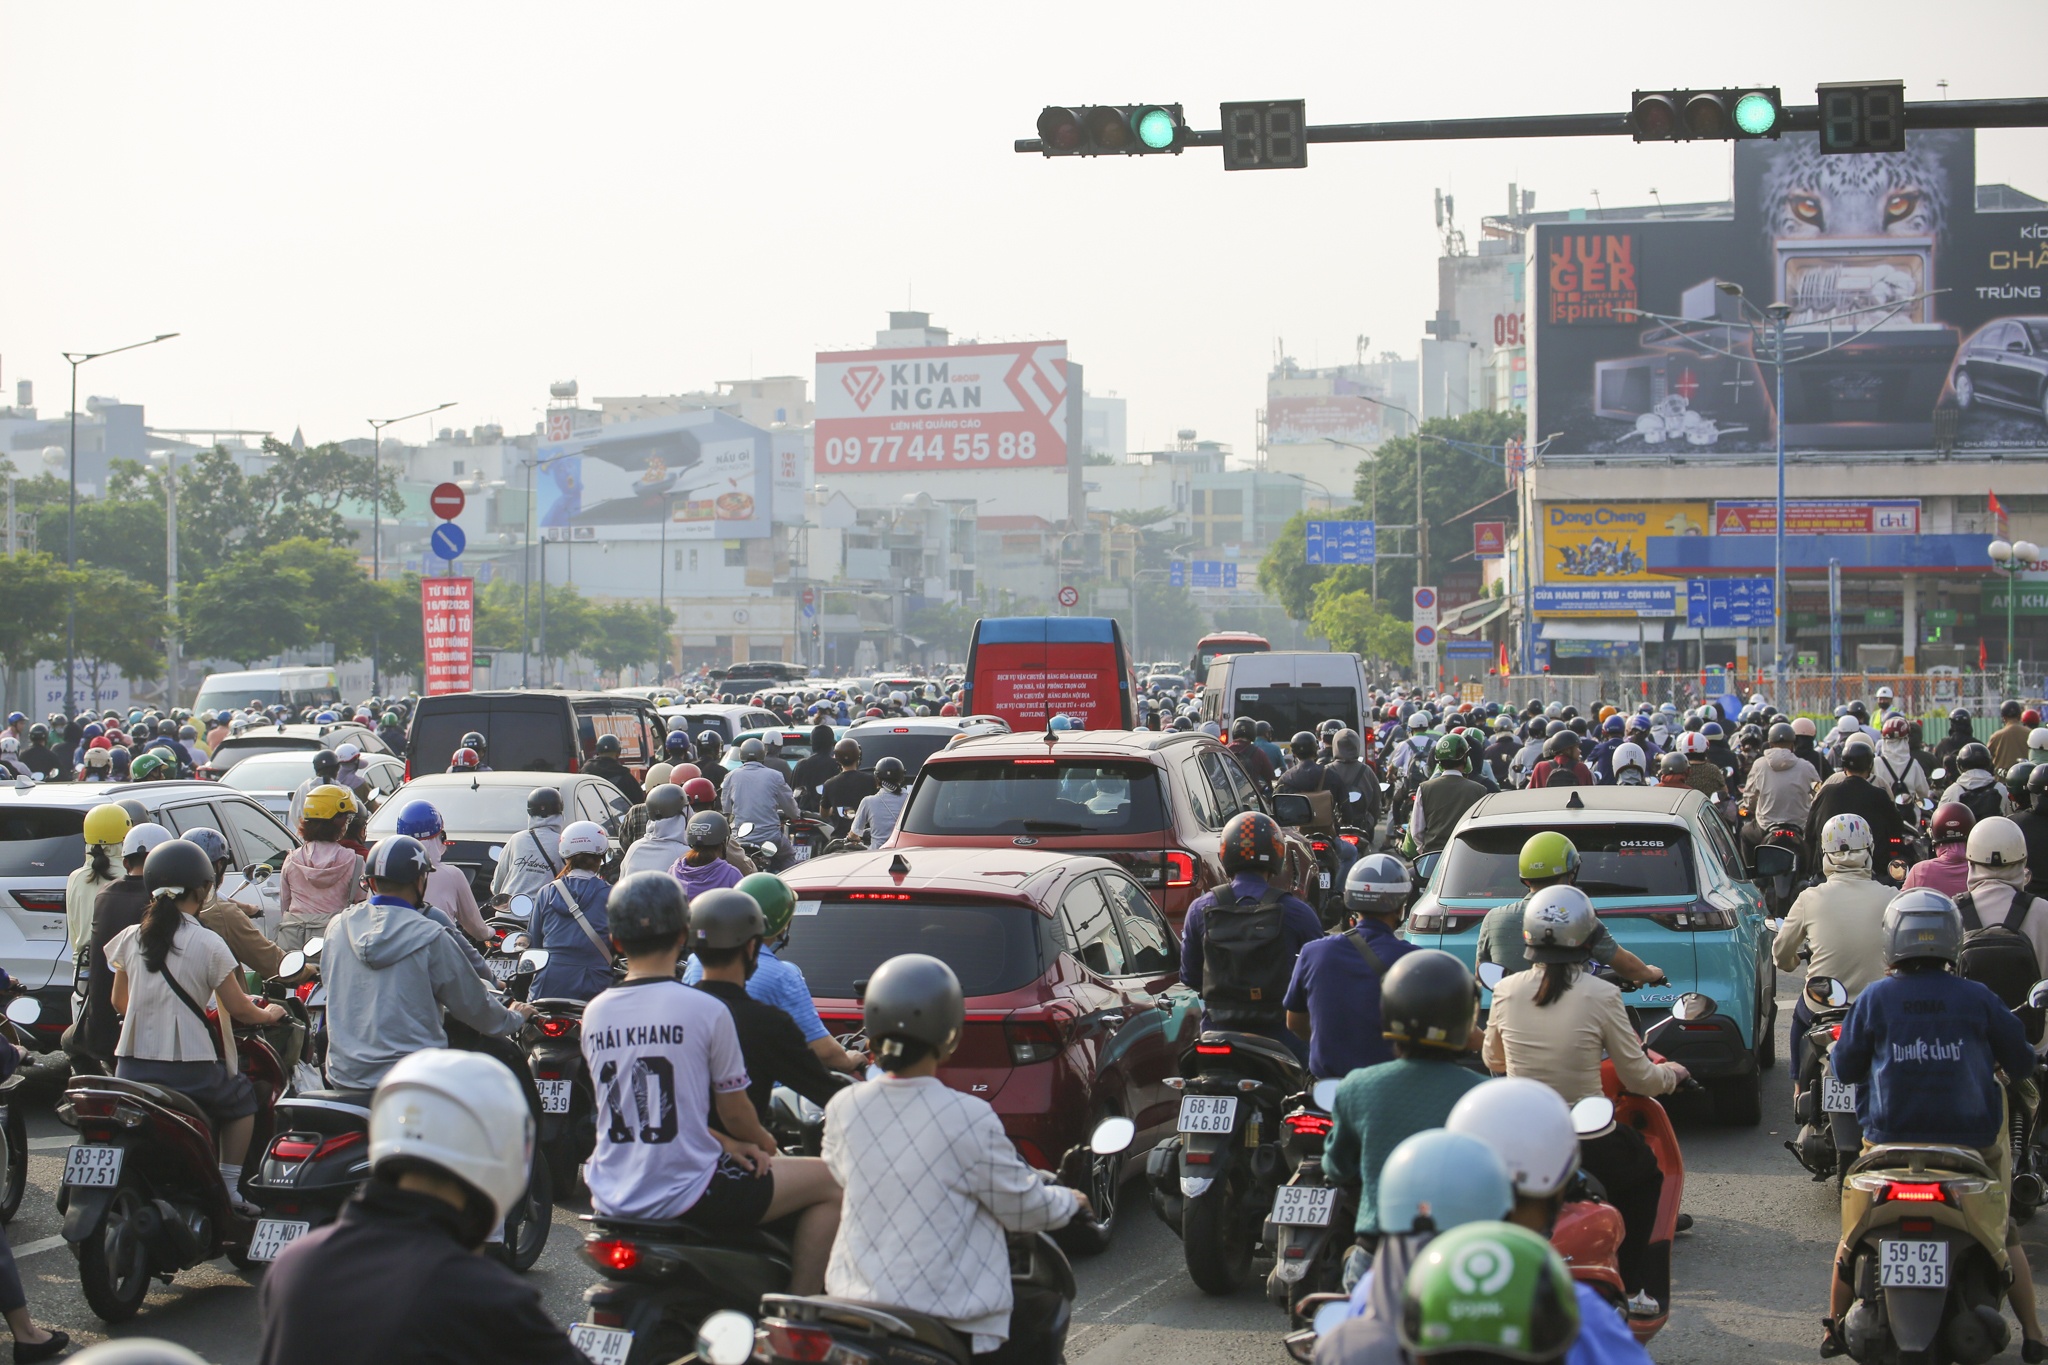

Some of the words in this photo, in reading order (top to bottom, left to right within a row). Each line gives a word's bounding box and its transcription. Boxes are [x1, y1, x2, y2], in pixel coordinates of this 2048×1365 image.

[1551, 235, 1631, 264] JUN
[1551, 263, 1637, 291] GER
[1976, 282, 2041, 299] TRÚNG
[1557, 299, 1613, 323] spirit
[891, 362, 949, 386] KIM
[951, 374, 980, 383] GROUP
[891, 386, 981, 411] NGAN
[891, 419, 910, 431] LIÊN
[825, 437, 861, 465] 09
[867, 435, 903, 463] 77
[907, 434, 944, 462] 44
[953, 433, 990, 462] 55
[998, 431, 1036, 460] 88
[1551, 508, 1593, 526] Dong
[1595, 508, 1646, 526] Cheng
[47, 690, 85, 702] SPCE
[142, 760, 155, 768] Grab
[1903, 1001, 1947, 1014] ROMA
[589, 1026, 620, 1053] THÁI
[626, 1025, 684, 1047] KHANG
[600, 1056, 678, 1144] 10
[1190, 1099, 1228, 1114] 68-AB
[1184, 1115, 1231, 1131] 146.80
[74, 1149, 114, 1166] 83-P3
[66, 1167, 116, 1184] 217.51
[1284, 1188, 1327, 1205] 59-D3
[1278, 1205, 1327, 1223] 131.67
[1889, 1242, 1938, 1263] 59-G2
[1883, 1264, 1944, 1285] 759.35
[576, 1329, 623, 1356] 69-AH
